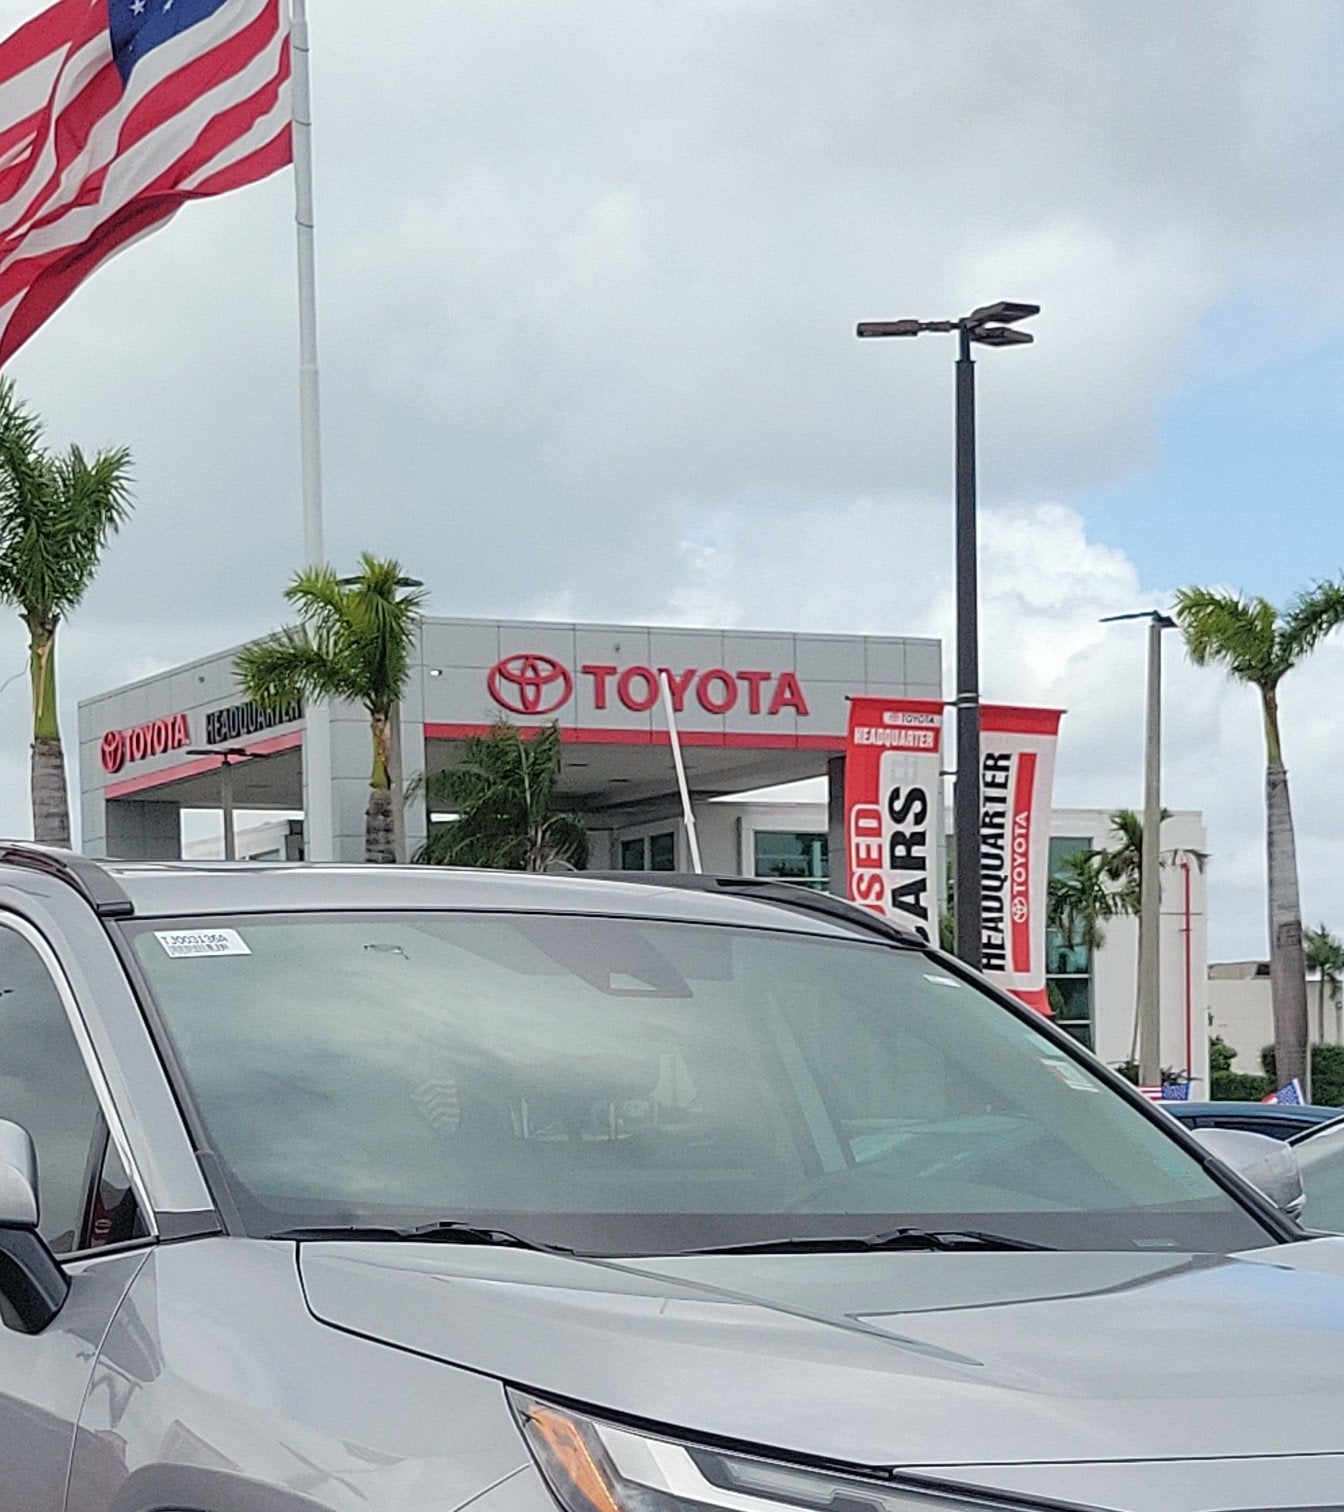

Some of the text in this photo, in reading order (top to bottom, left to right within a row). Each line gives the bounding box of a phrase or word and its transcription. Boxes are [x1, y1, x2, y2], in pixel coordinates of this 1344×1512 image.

[582, 664, 810, 717] TOYOTA
[901, 714, 936, 725] TOYOTA
[126, 713, 190, 762] TOYOTA
[854, 727, 935, 749] HEADQUARTER
[855, 809, 886, 917] SED
[888, 786, 929, 944] ARS
[981, 752, 1013, 973] HEADQUARTER
[1012, 811, 1029, 896] TOYOTA
